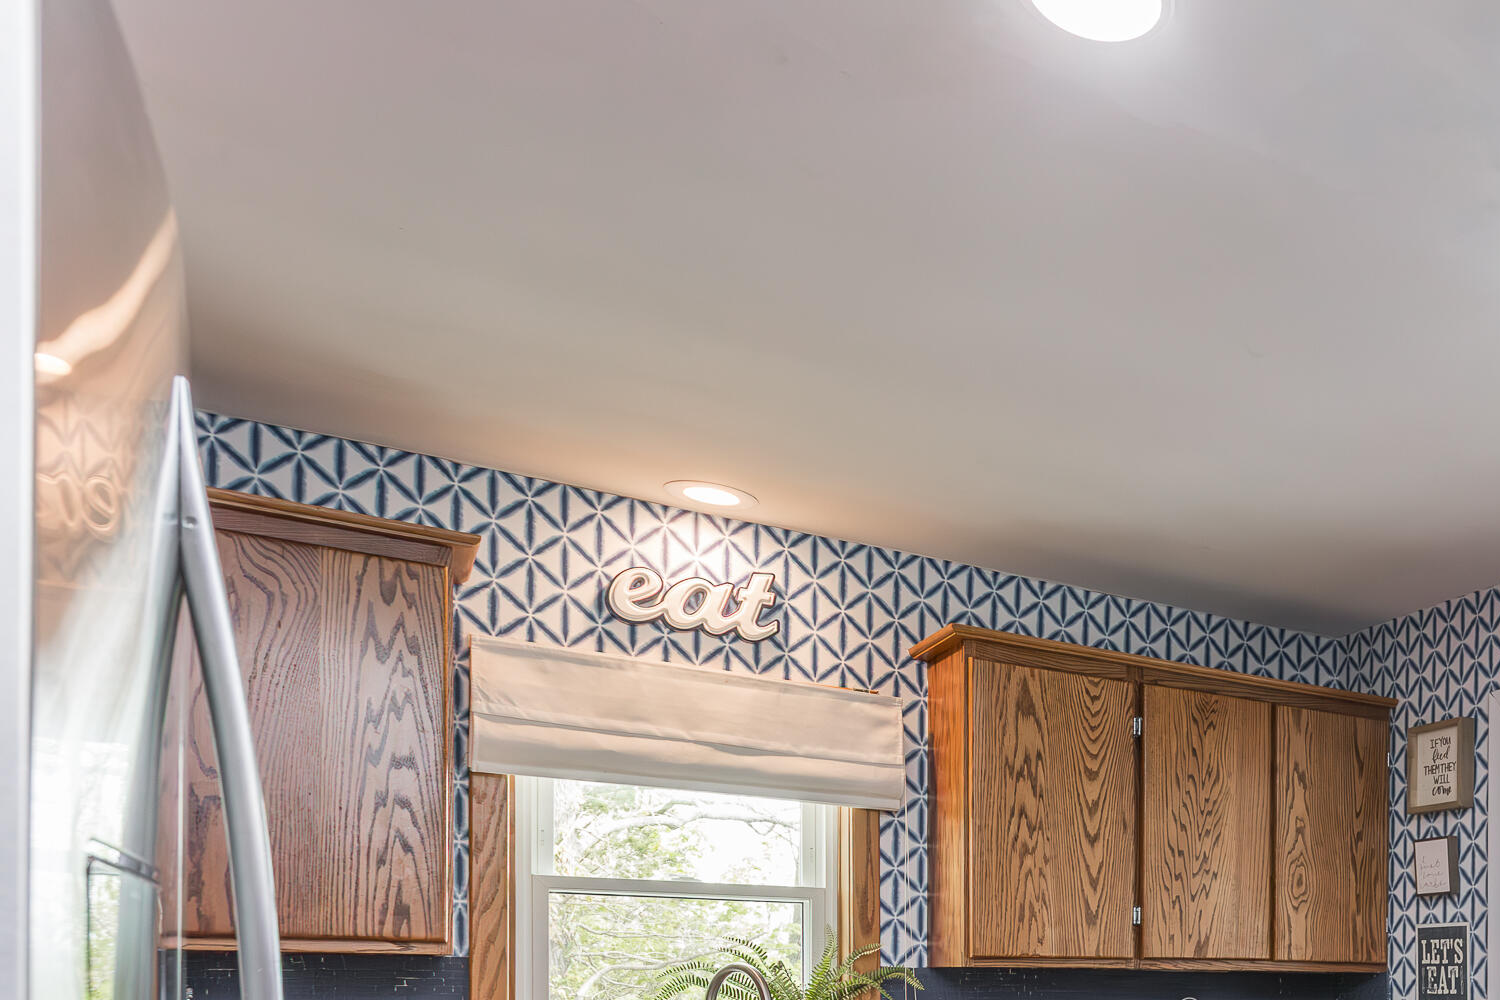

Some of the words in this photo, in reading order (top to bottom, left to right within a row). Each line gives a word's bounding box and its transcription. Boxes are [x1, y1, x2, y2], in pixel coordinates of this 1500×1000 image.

[605, 566, 781, 645] eat
[1430, 739, 1439, 750] IF
[1432, 746, 1451, 763] feed
[1424, 764, 1440, 776] THEM
[1440, 761, 1456, 774] THEY
[1433, 774, 1450, 785] WILL
[1432, 785, 1452, 796] come
[1421, 938, 1464, 965] LET'S
[1426, 965, 1459, 995] EAT
